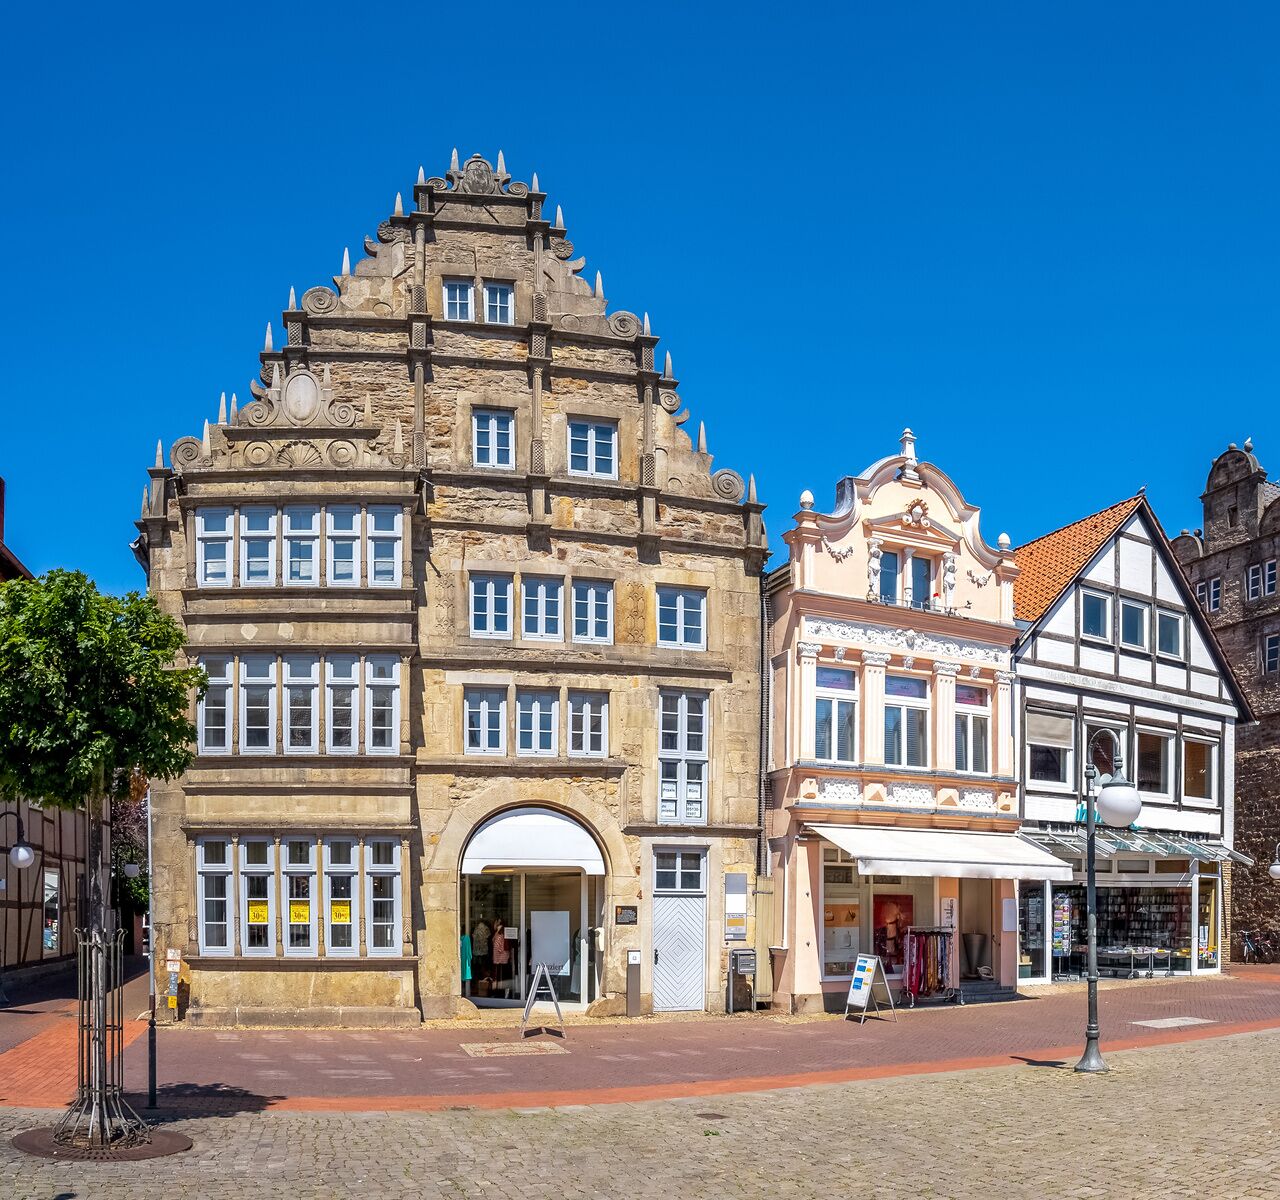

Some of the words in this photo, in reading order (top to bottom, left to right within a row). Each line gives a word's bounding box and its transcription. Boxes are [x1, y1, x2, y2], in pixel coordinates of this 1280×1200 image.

[636, 889, 643, 900] 4
[251, 912, 266, 921] 30%
[293, 912, 307, 921] 30%
[334, 912, 348, 921] 30%
